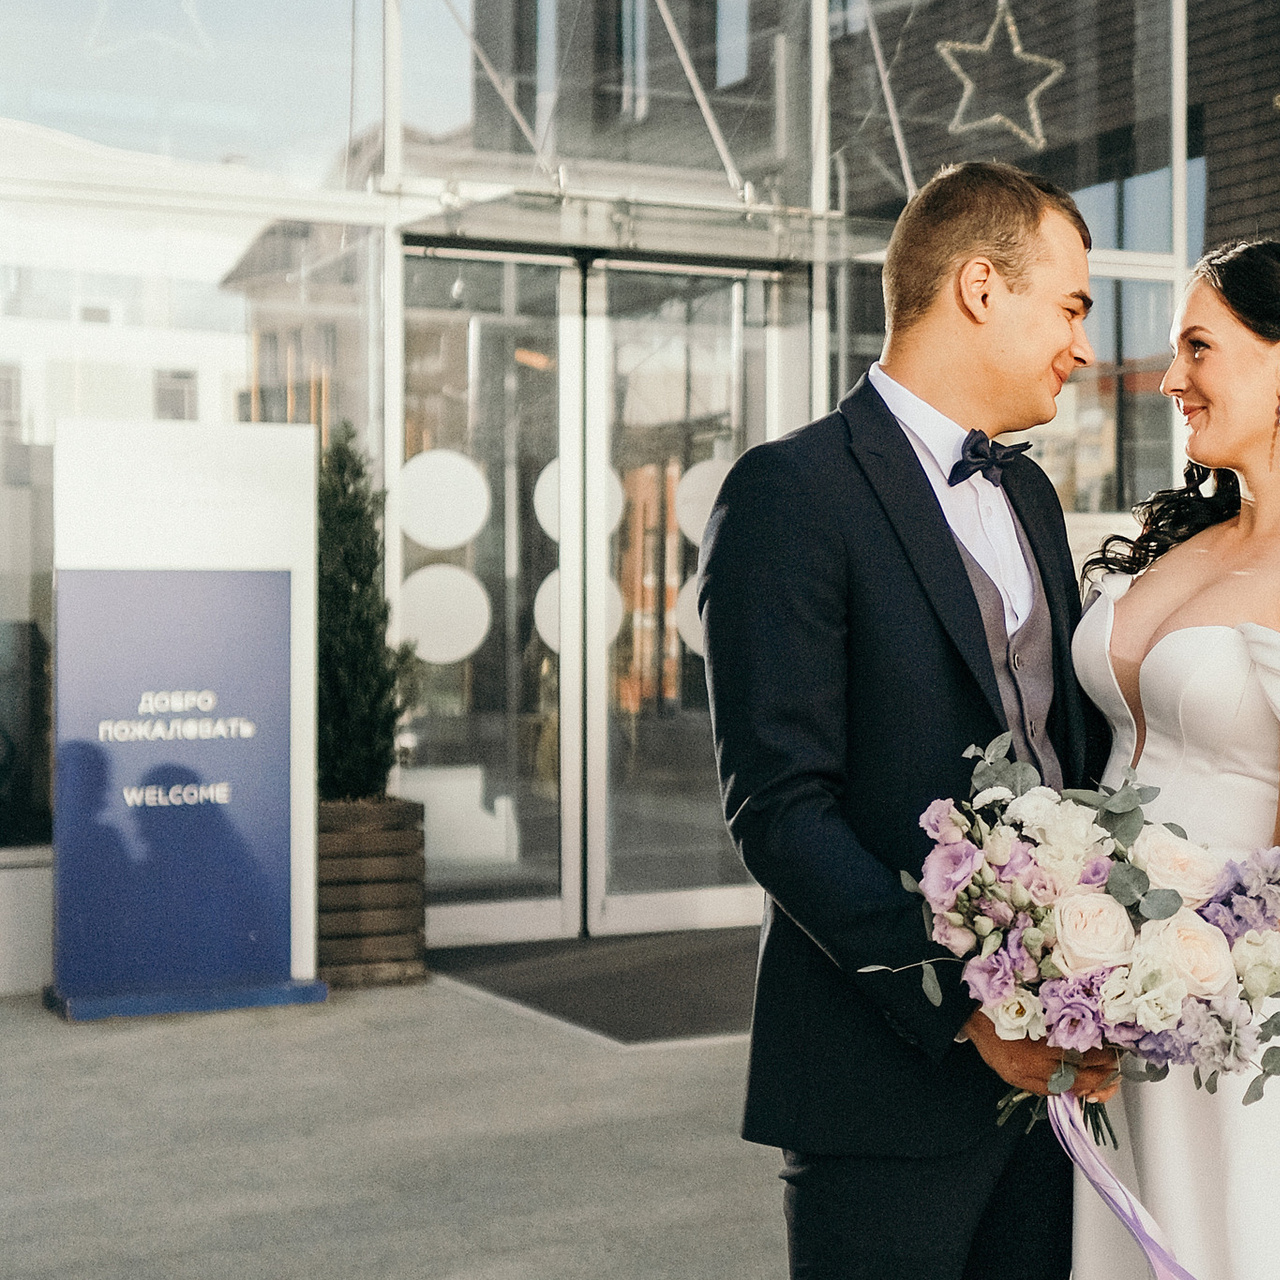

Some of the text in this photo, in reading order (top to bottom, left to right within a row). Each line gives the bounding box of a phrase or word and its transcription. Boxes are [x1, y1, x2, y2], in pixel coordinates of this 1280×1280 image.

[138, 689, 217, 715] ДОБРО
[98, 717, 256, 742] ПОЖАЛОВАТЬ
[122, 782, 231, 807] WELCOME
